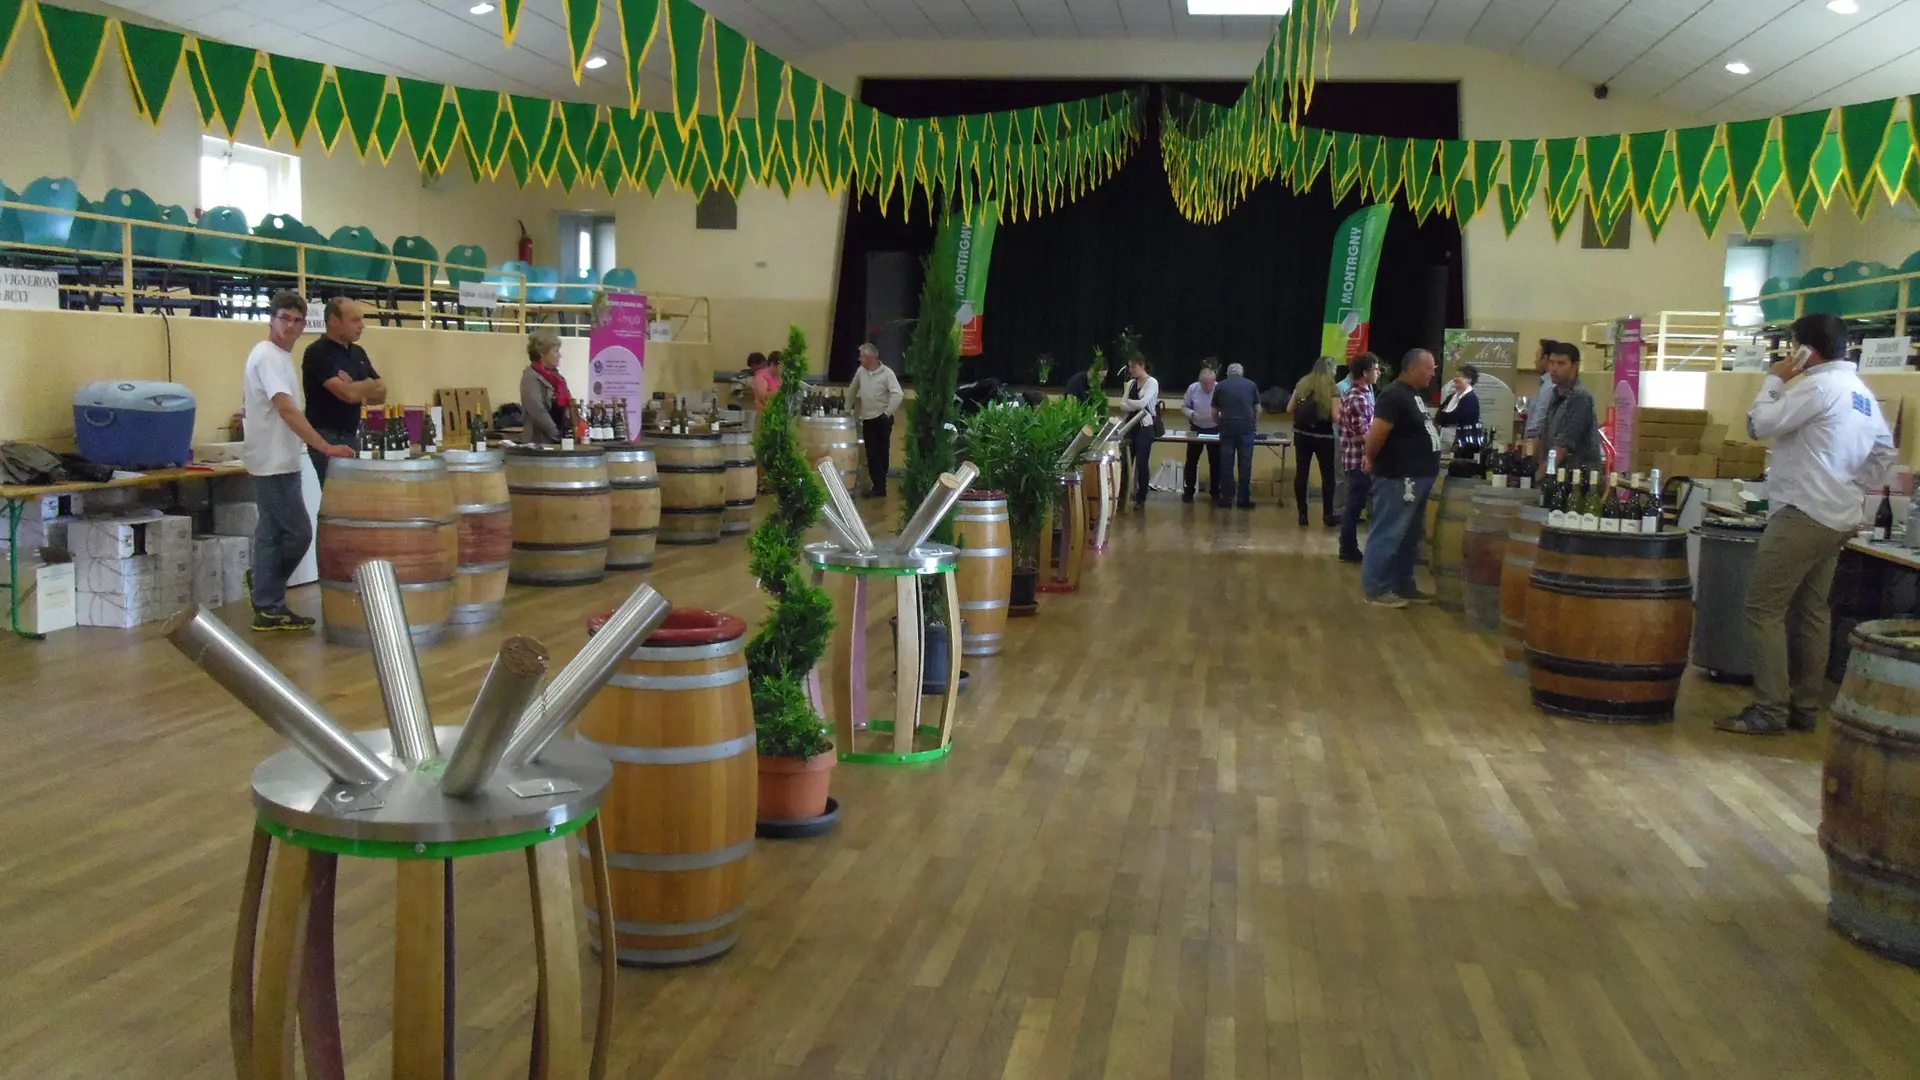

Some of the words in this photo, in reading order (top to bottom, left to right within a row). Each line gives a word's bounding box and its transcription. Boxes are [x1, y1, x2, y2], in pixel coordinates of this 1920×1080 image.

[954, 222, 973, 295] MONTAGNY
[1342, 227, 1361, 303] MONTAGNY
[4, 273, 57, 289] VIGNERONS
[4, 289, 28, 302] BUXY
